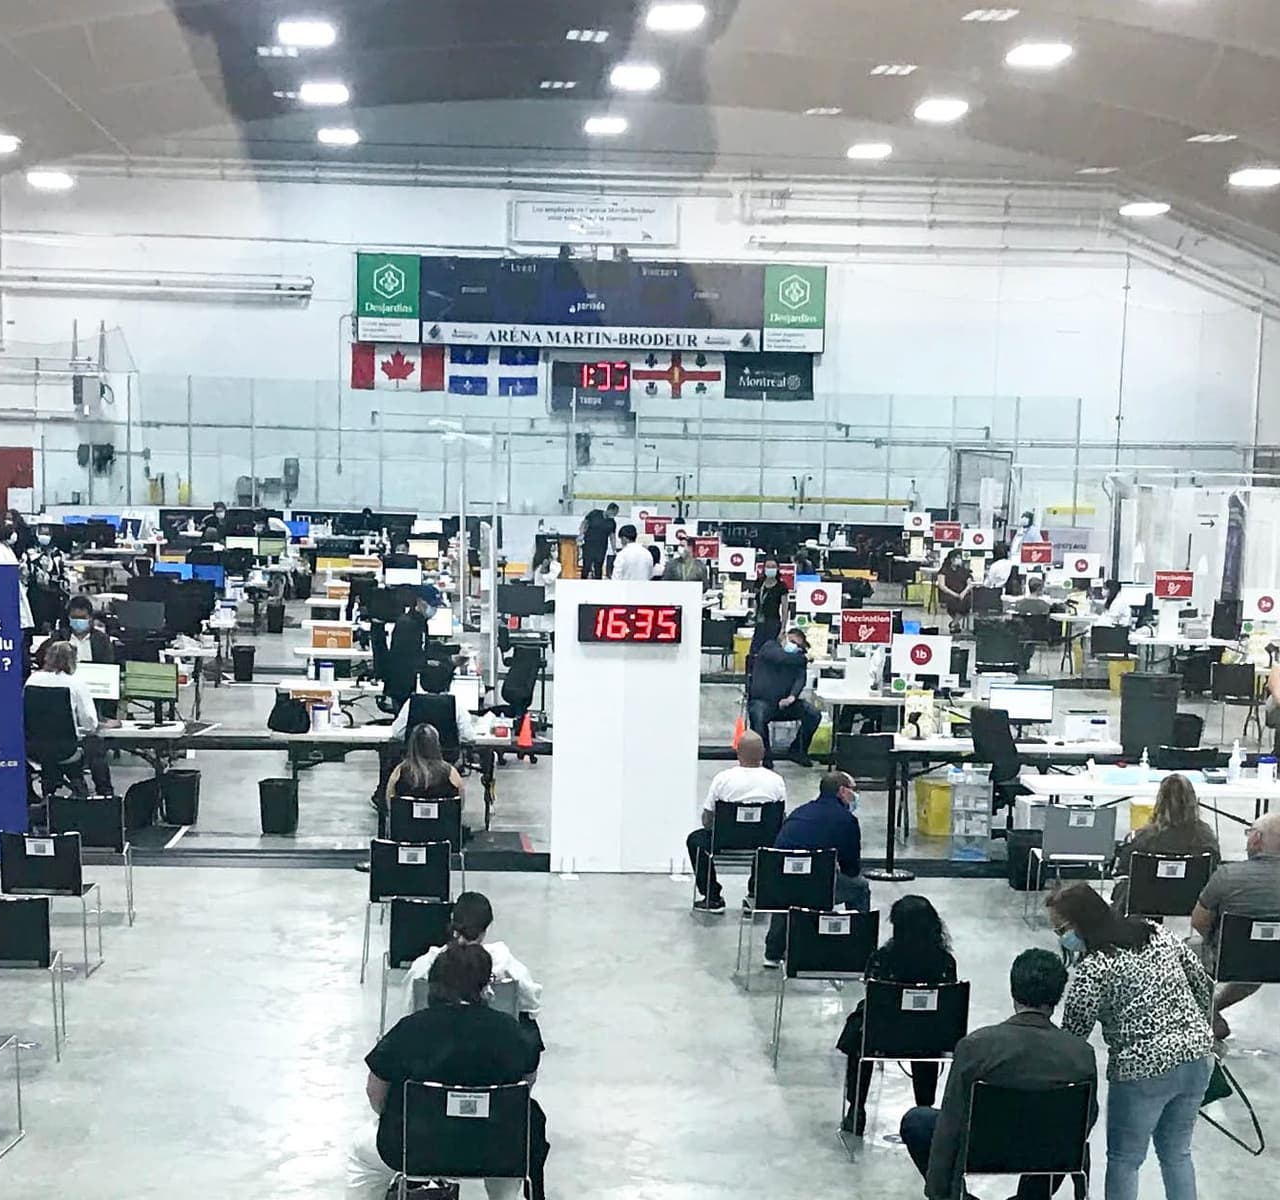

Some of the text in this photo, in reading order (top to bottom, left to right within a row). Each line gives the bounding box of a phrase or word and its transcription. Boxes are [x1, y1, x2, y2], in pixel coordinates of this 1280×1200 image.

[365, 302, 413, 314] Desjardins
[485, 326, 542, 344] ARÉNA
[546, 329, 698, 347] MARTIN-BRODEUR
[596, 608, 676, 638] 16:35
[843, 615, 890, 623] Vaccination
[914, 650, 927, 659] 1b
[2, 657, 12, 671] ?
